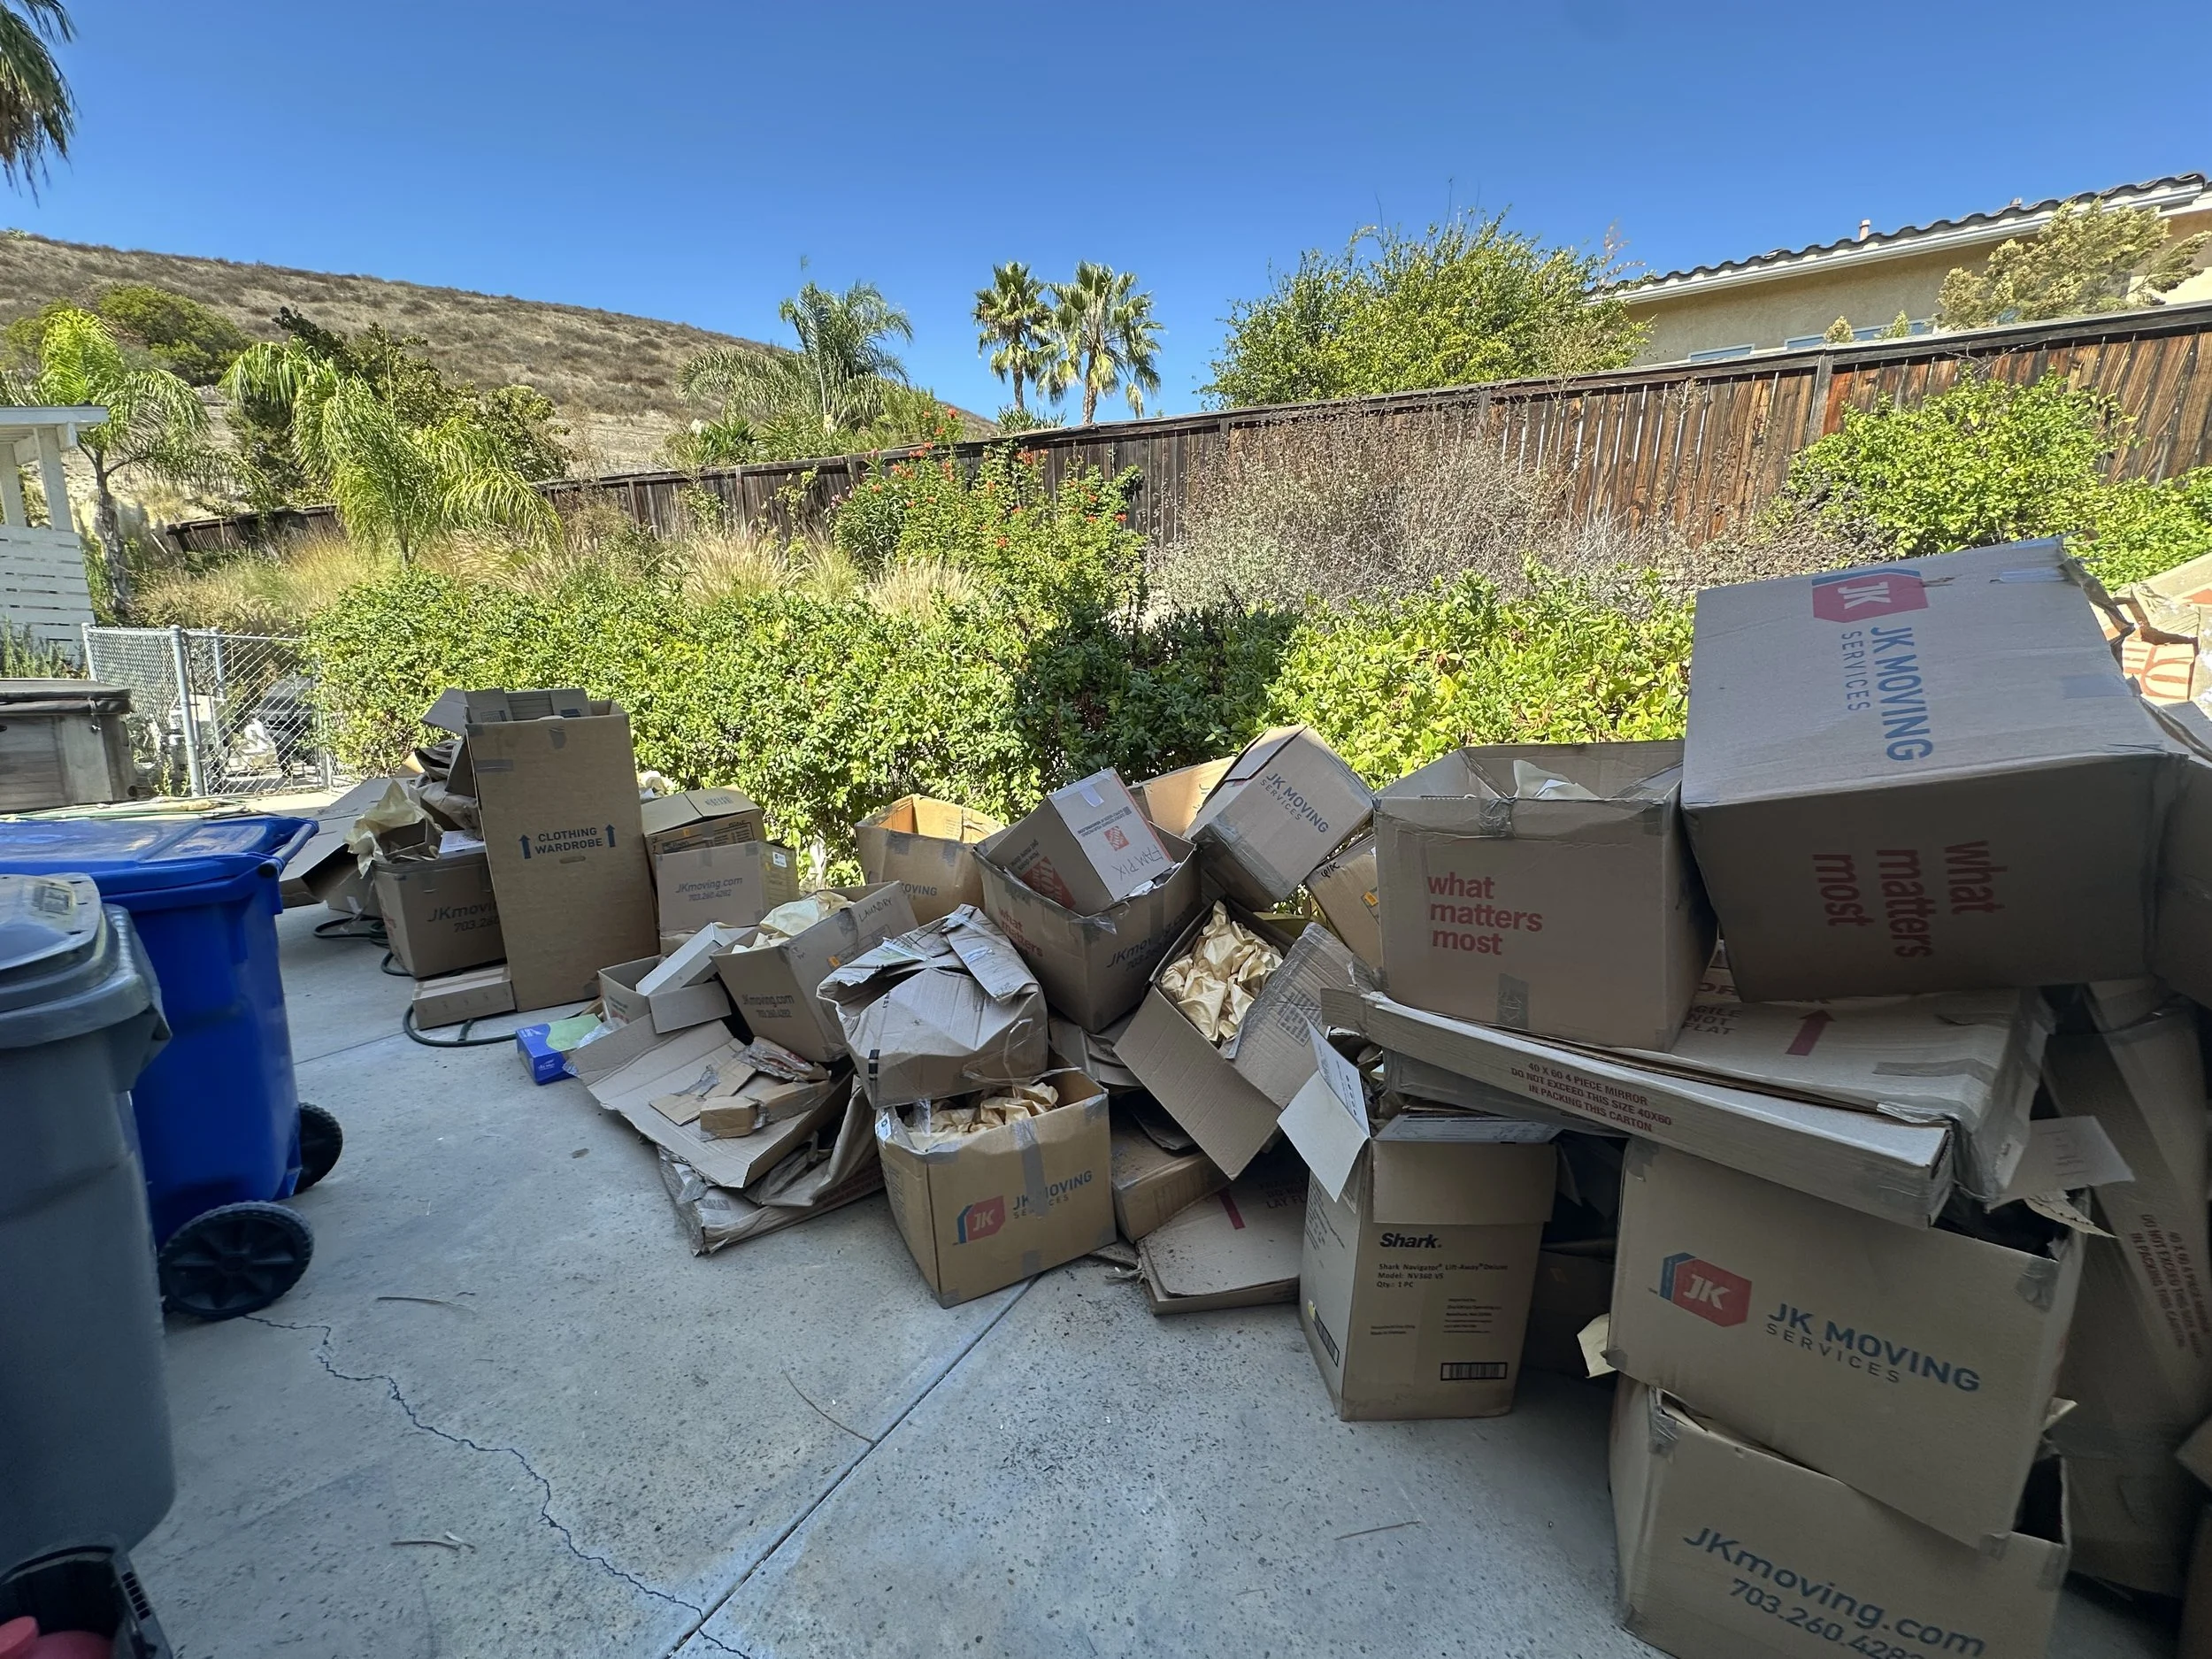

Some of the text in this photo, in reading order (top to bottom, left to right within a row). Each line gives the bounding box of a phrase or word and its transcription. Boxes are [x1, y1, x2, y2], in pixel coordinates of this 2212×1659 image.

[1837, 581, 1892, 610] JK
[1841, 631, 1871, 711] SERVICES
[1870, 626, 1933, 762] JK MOVING
[1260, 779, 1303, 821] SERVICES
[1266, 772, 1329, 833] JK MOVING
[534, 838, 603, 855] WARDROBE
[538, 827, 597, 842] CLOTHING
[675, 877, 743, 894] JKmoving.com
[1427, 872, 1495, 900] what
[1812, 853, 1875, 926] most
[1943, 840, 2008, 916] what
[858, 896, 894, 922] LAUNDRY
[999, 906, 1024, 928] what
[1430, 902, 1543, 933] matters
[1876, 849, 1938, 957] matters
[1432, 929, 1503, 956] most
[1510, 1067, 1672, 1125] DO NOT EXCEED THIS SIZE 40X60
[1528, 1062, 1648, 1106] 40 X 60 4 PIECE MIRROR
[1529, 1084, 1652, 1133] IN PACKING THIS CARTON
[1045, 1170, 1093, 1198] OVING
[973, 1208, 995, 1231] JK
[1683, 1273, 1731, 1310] JK
[1766, 1323, 1901, 1385] SERVICES
[1768, 1302, 1981, 1393] JK MOVING
[1683, 1527, 1986, 1658] JKmoving.com
